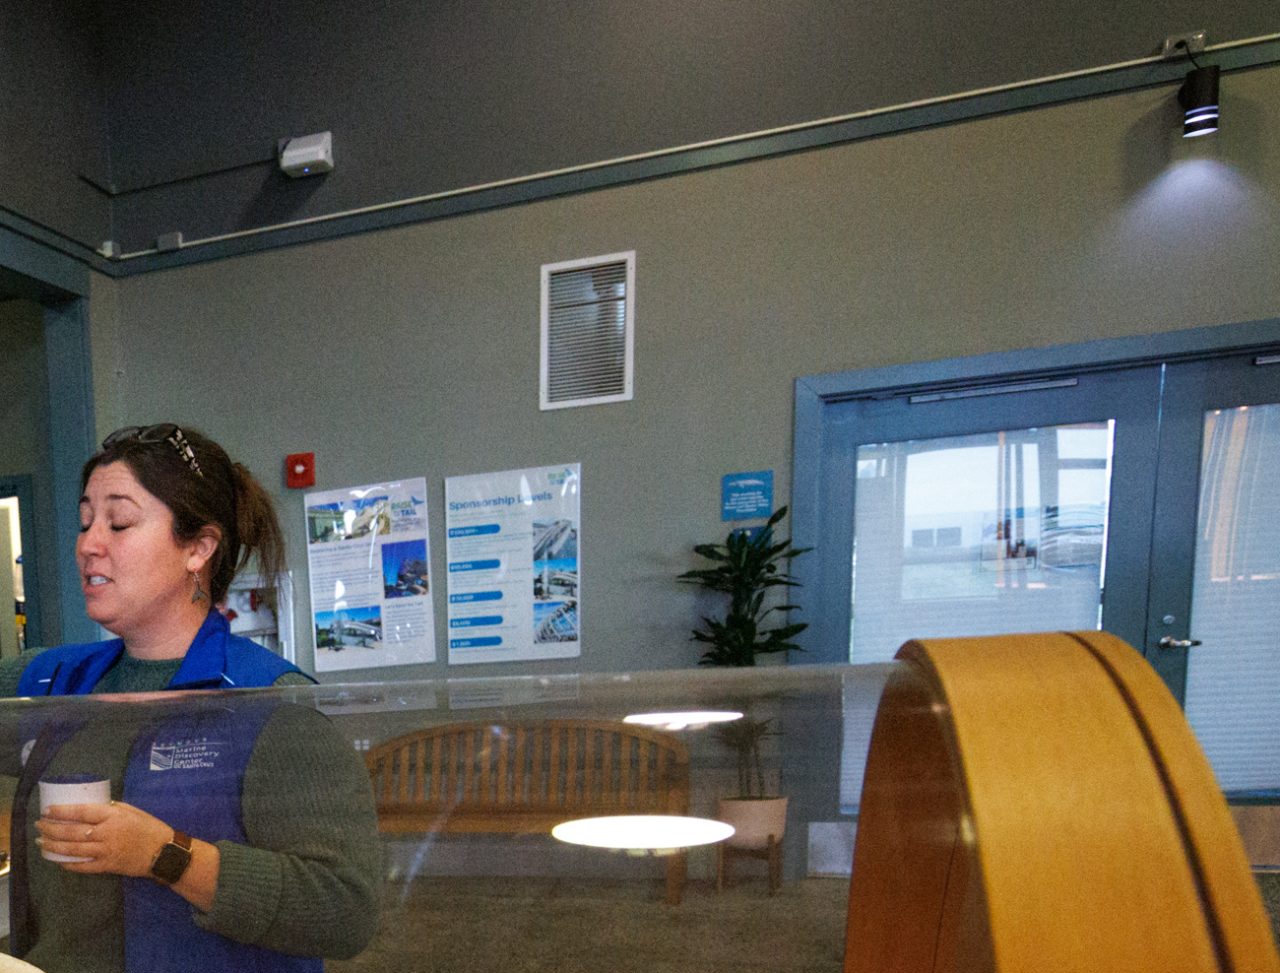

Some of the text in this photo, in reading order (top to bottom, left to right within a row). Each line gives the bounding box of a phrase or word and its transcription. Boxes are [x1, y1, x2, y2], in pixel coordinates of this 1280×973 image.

[449, 495, 515, 511] Sponsorship
[175, 745, 207, 754] Marine
[174, 750, 219, 759] Discovery
[173, 757, 203, 765] Center
